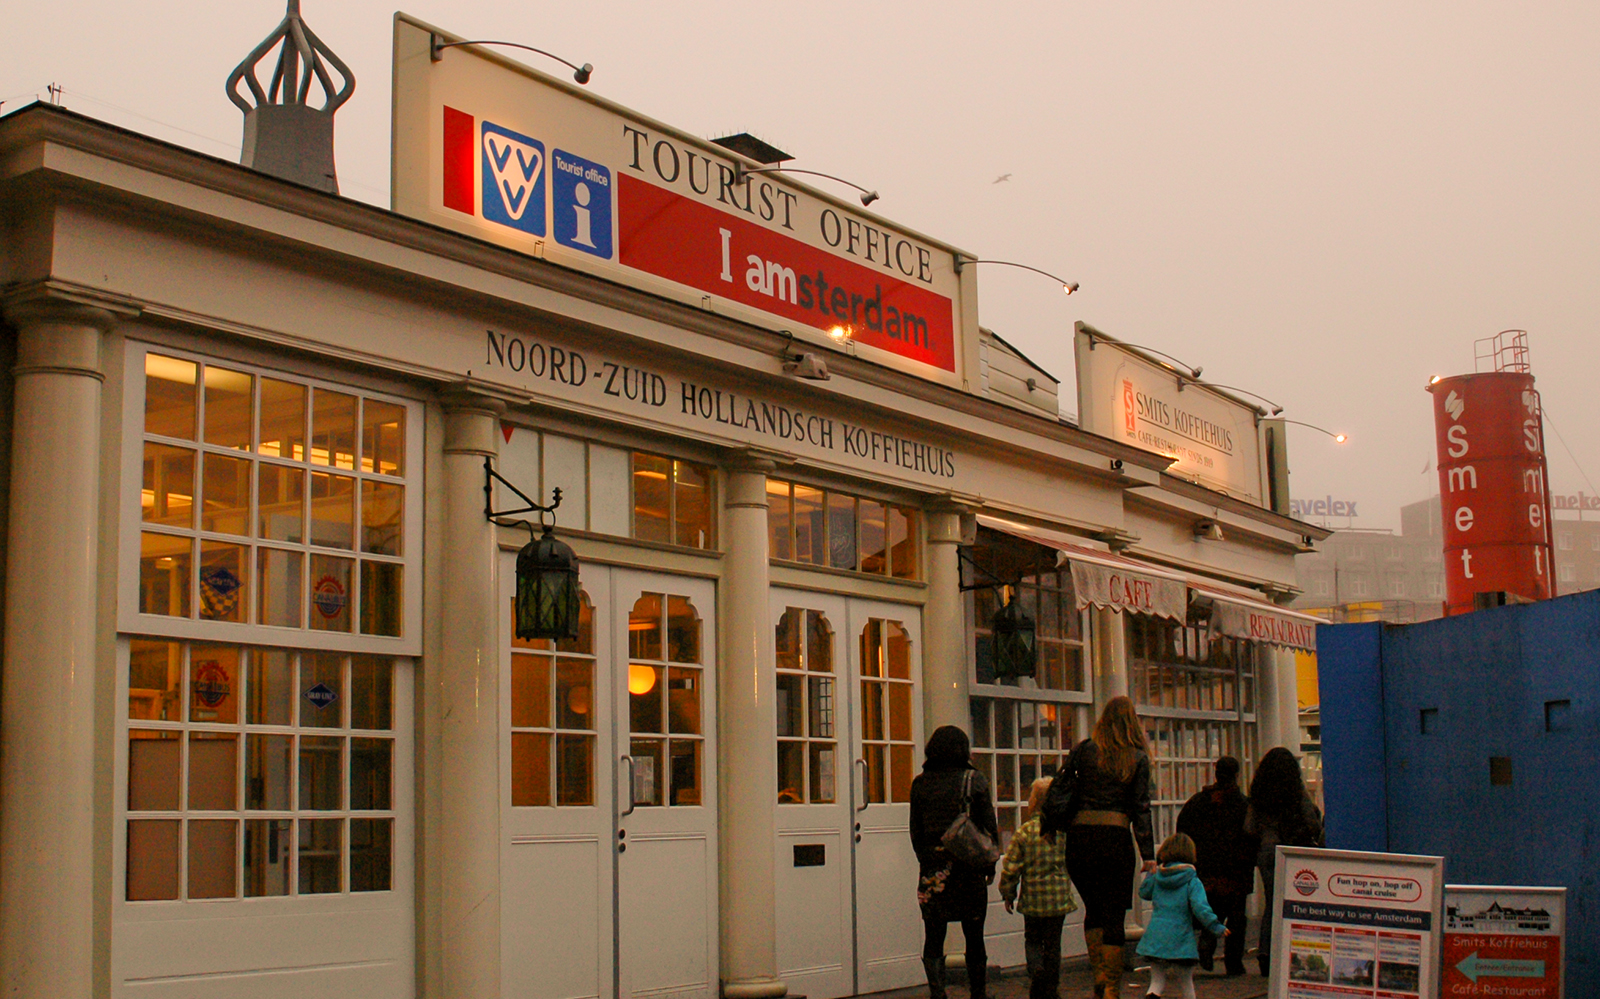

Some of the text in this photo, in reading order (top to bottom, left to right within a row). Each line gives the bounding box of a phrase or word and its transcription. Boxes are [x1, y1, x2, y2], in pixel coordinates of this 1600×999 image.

[556, 155, 608, 186] Tourist office
[623, 124, 933, 284] TOURIST OFFICE
[719, 227, 929, 349] I amsterdam
[680, 381, 834, 450] HOLLANDSCH
[842, 422, 956, 479] KOFFIEHUIS
[1136, 391, 1233, 452] SMITS KOFFIEHUIS
[1109, 574, 1153, 609] CAFE
[1250, 613, 1313, 648] RESTAURANT
[1336, 877, 1351, 885] Fun
[1352, 878, 1368, 888] hop
[1384, 880, 1399, 890] hop
[1401, 882, 1413, 890] off
[1352, 888, 1397, 898] canal cruise
[1292, 904, 1307, 914] The
[1309, 906, 1326, 916] best
[1328, 909, 1345, 918] way
[1358, 912, 1372, 920] see
[1373, 912, 1423, 924] Amsterdam
[1452, 936, 1549, 948] Smits Koffiehuis
